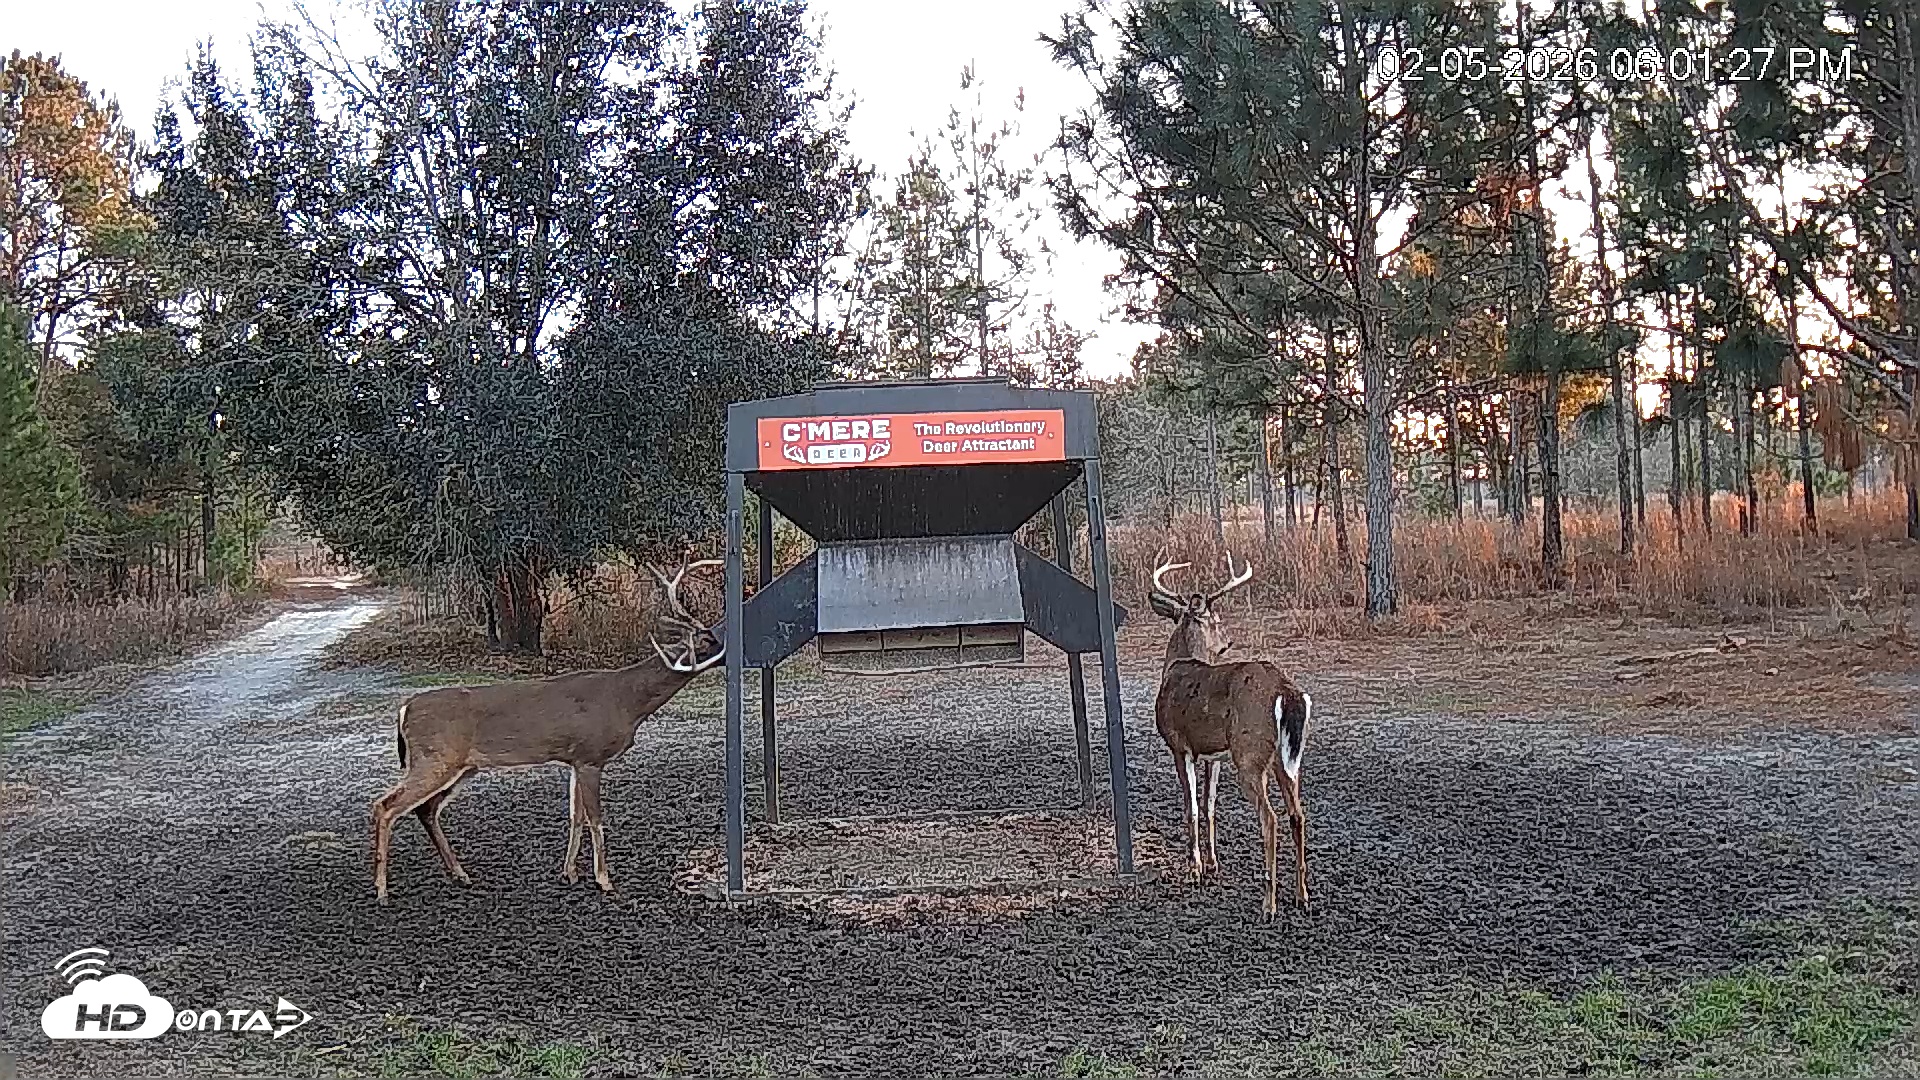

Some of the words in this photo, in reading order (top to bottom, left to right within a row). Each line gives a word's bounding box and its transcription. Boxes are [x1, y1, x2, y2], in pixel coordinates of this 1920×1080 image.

[782, 419, 891, 442] C'MERE
[914, 422, 942, 437] The
[945, 420, 1046, 436] Revolutionary
[922, 439, 957, 453] Deer
[961, 437, 1036, 452] Attractant
